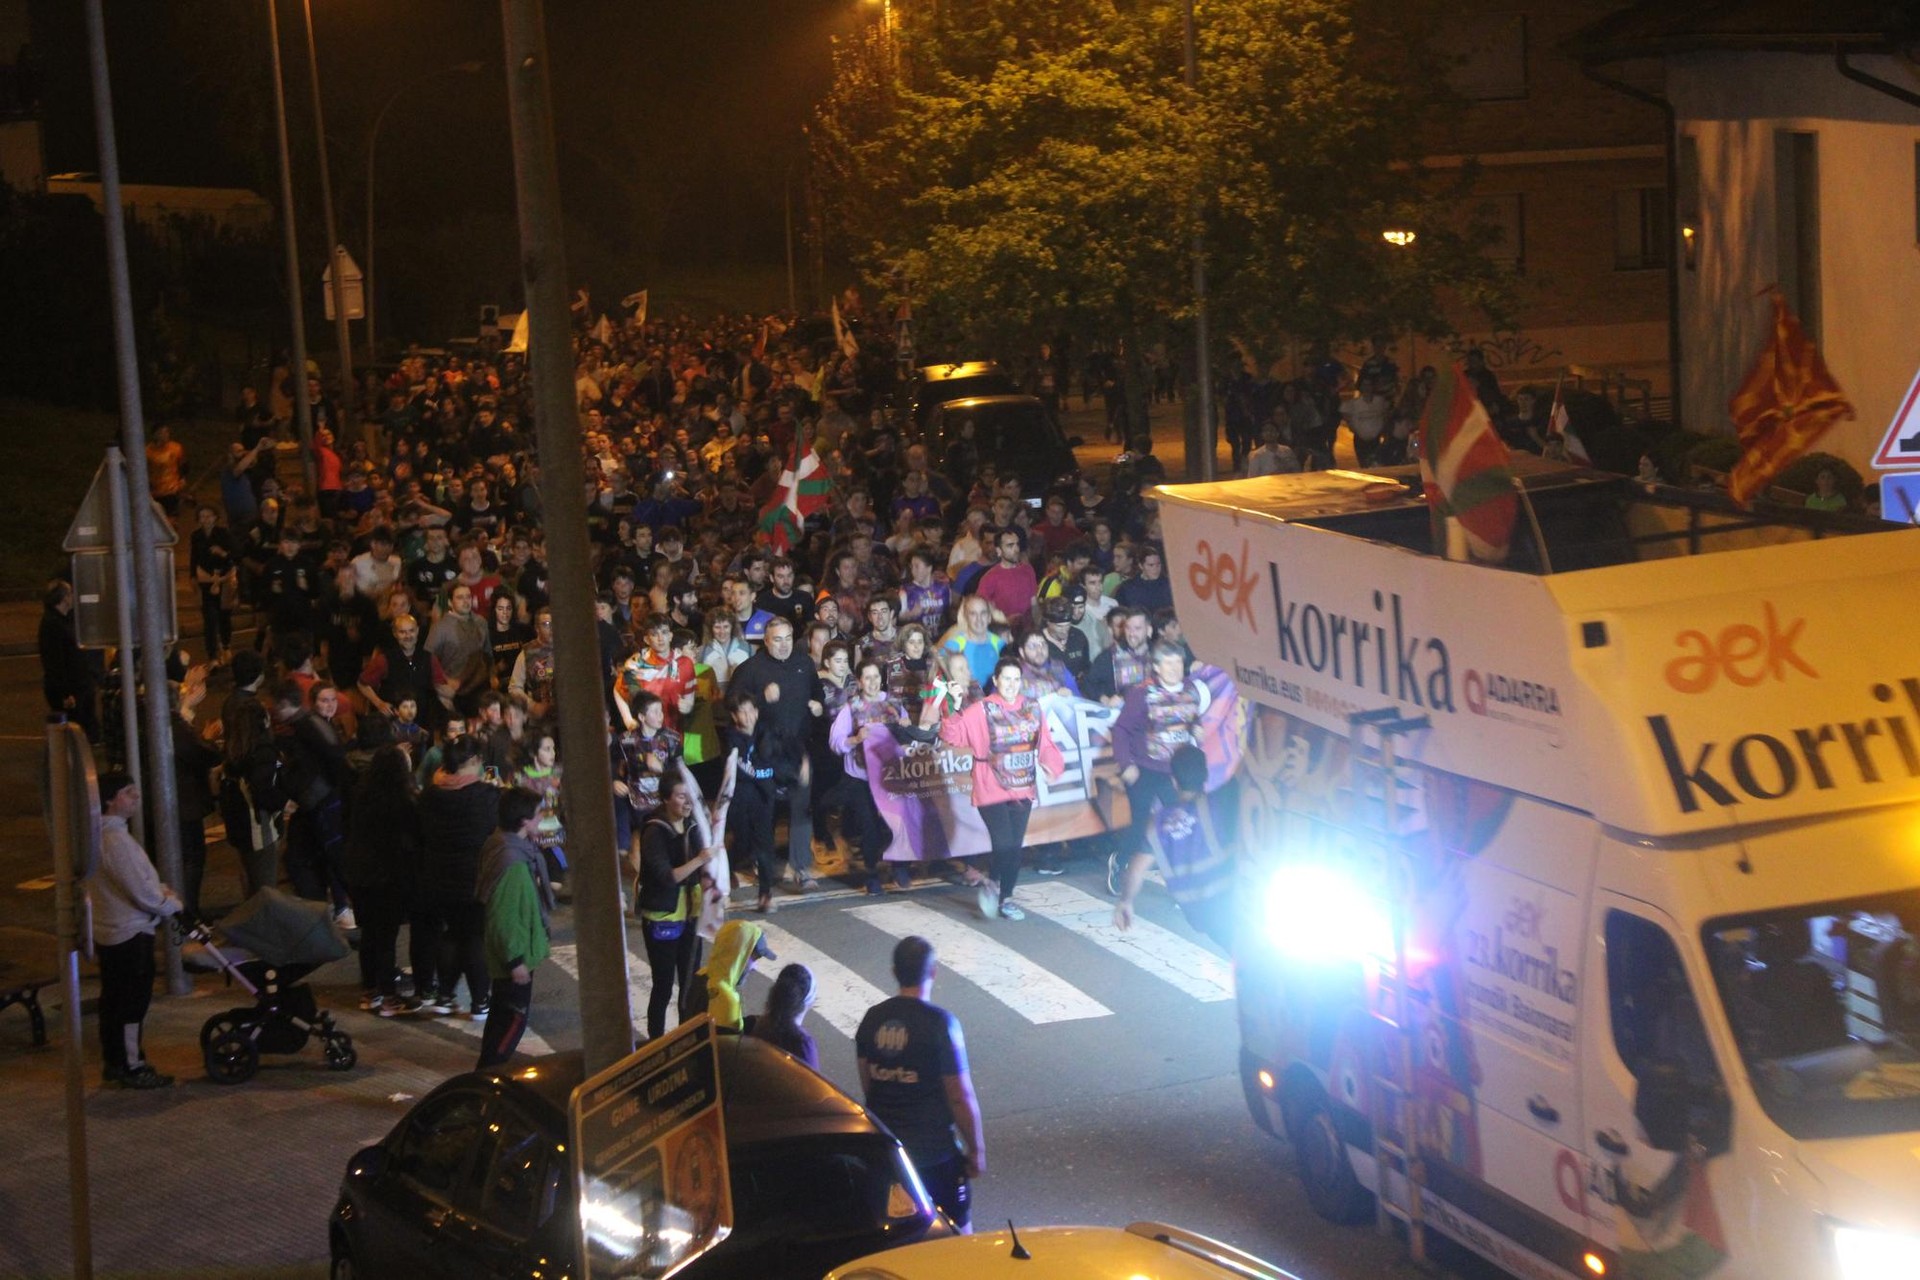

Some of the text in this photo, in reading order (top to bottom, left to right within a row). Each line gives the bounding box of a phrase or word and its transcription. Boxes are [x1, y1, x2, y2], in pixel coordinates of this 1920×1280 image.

[1189, 538, 1259, 635] aek
[1269, 561, 1457, 714] korrika
[1664, 600, 1821, 694] aek
